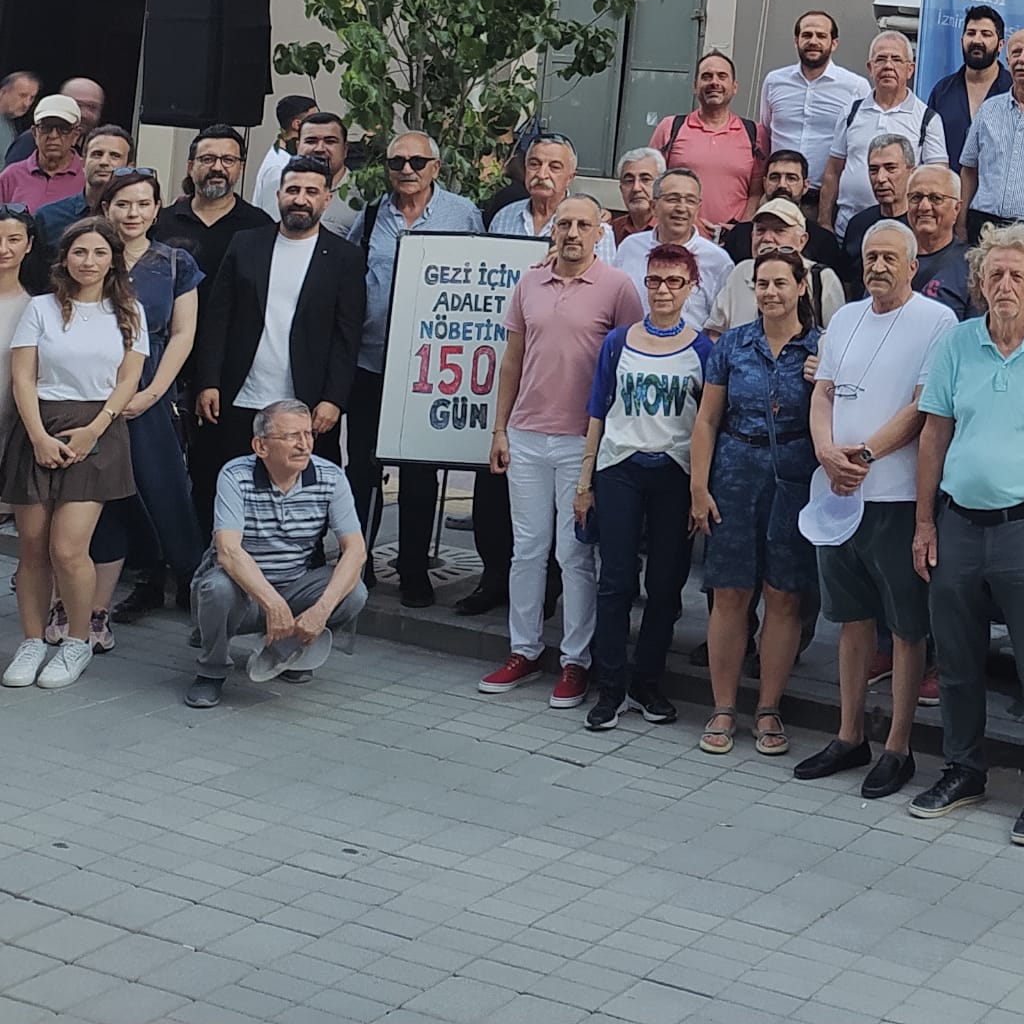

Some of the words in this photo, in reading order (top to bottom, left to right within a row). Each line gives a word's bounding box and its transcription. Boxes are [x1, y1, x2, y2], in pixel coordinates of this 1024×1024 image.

[424, 262, 472, 286] GEZİ
[478, 262, 521, 291] İÇİN
[432, 291, 506, 314] ADALET
[412, 343, 497, 396] 150
[620, 373, 692, 417] WOW
[429, 396, 489, 430] GÜN
